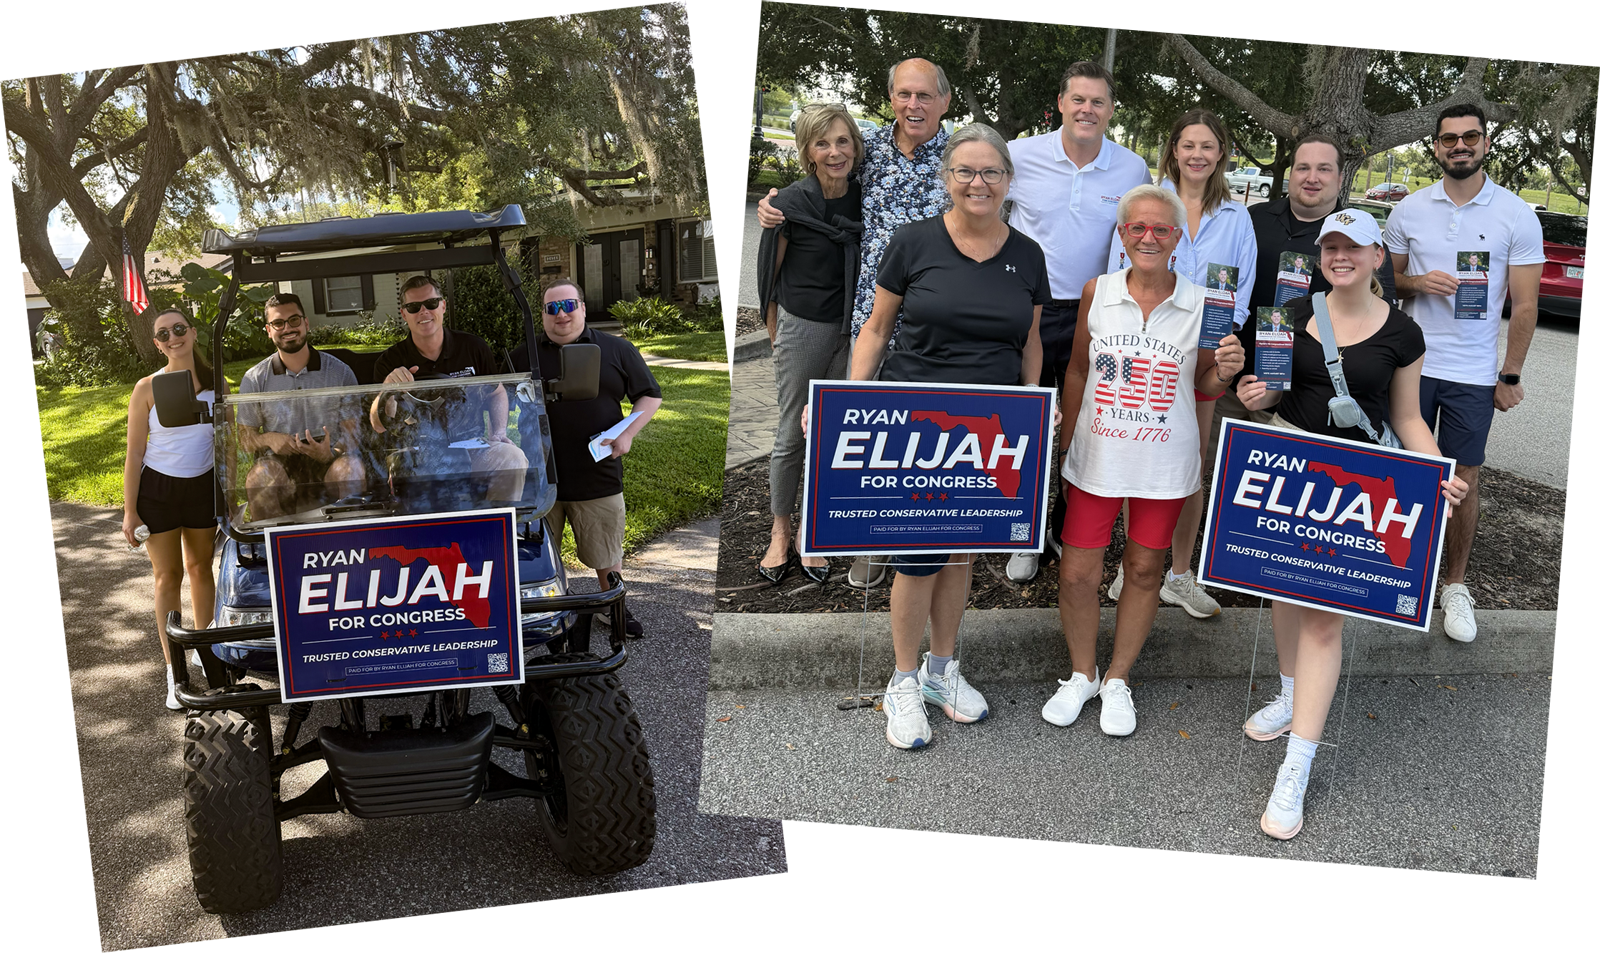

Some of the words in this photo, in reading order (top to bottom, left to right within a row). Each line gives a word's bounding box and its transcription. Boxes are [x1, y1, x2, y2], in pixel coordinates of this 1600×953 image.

[1092, 334, 1140, 353] UNITED
[1143, 336, 1187, 365] STATES
[1094, 352, 1180, 412] 250
[843, 409, 909, 425] RYAN
[1110, 407, 1150, 423] YEARS
[1090, 417, 1129, 439] Since
[1132, 426, 1172, 442] 1776
[831, 431, 1029, 470] ELIJAH
[1247, 449, 1307, 473] RYAN
[861, 476, 897, 488] FOR
[902, 476, 997, 488] CONGRESS
[829, 510, 877, 518] TRUSTED
[879, 509, 959, 517] CONSERVATIVE
[960, 509, 1023, 517] LEADERSHIP
[1233, 469, 1423, 539] ELIJAH
[1256, 516, 1290, 534] FOR
[1294, 524, 1386, 553] CONGRESS
[303, 548, 365, 569] RYAN
[1226, 543, 1269, 559] TRUSTED
[1271, 553, 1346, 575] CONSERVATIVE
[1347, 569, 1411, 589] LEADERSHIP
[298, 560, 493, 614] ELIJAH
[329, 616, 365, 631] FOR
[370, 608, 466, 627] CONGRESS
[303, 652, 350, 663] TRUSTED
[352, 644, 431, 658] CONSERVATIVE
[433, 639, 498, 652] LEADERSHIP
